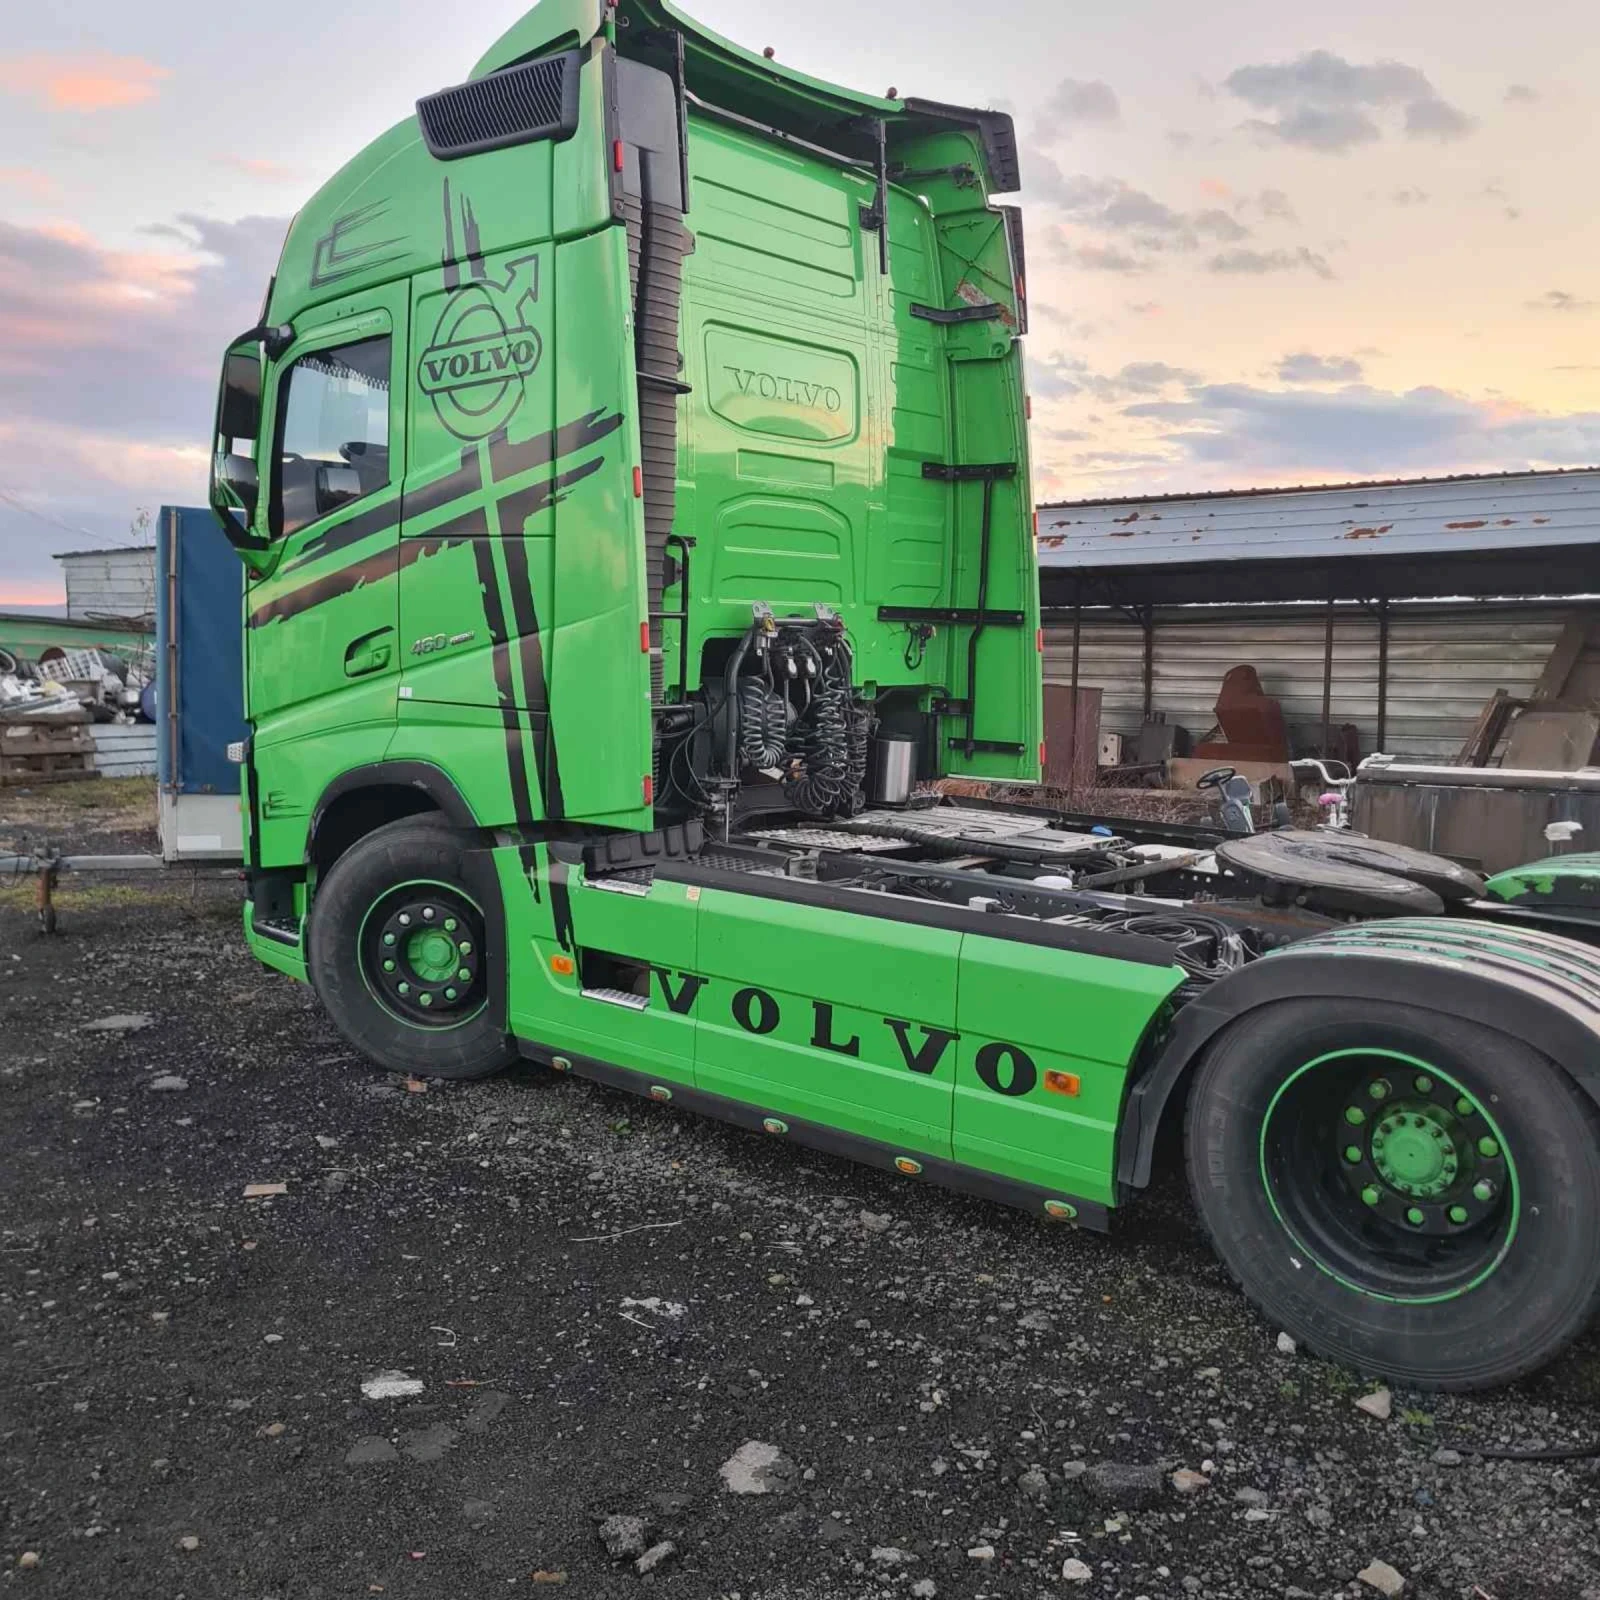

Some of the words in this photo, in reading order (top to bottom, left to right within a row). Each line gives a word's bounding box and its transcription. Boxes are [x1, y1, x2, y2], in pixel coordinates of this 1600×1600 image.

[424, 340, 535, 382] VOLVO
[723, 366, 841, 412] VOLVO
[650, 968, 1037, 1097] VOLVO
